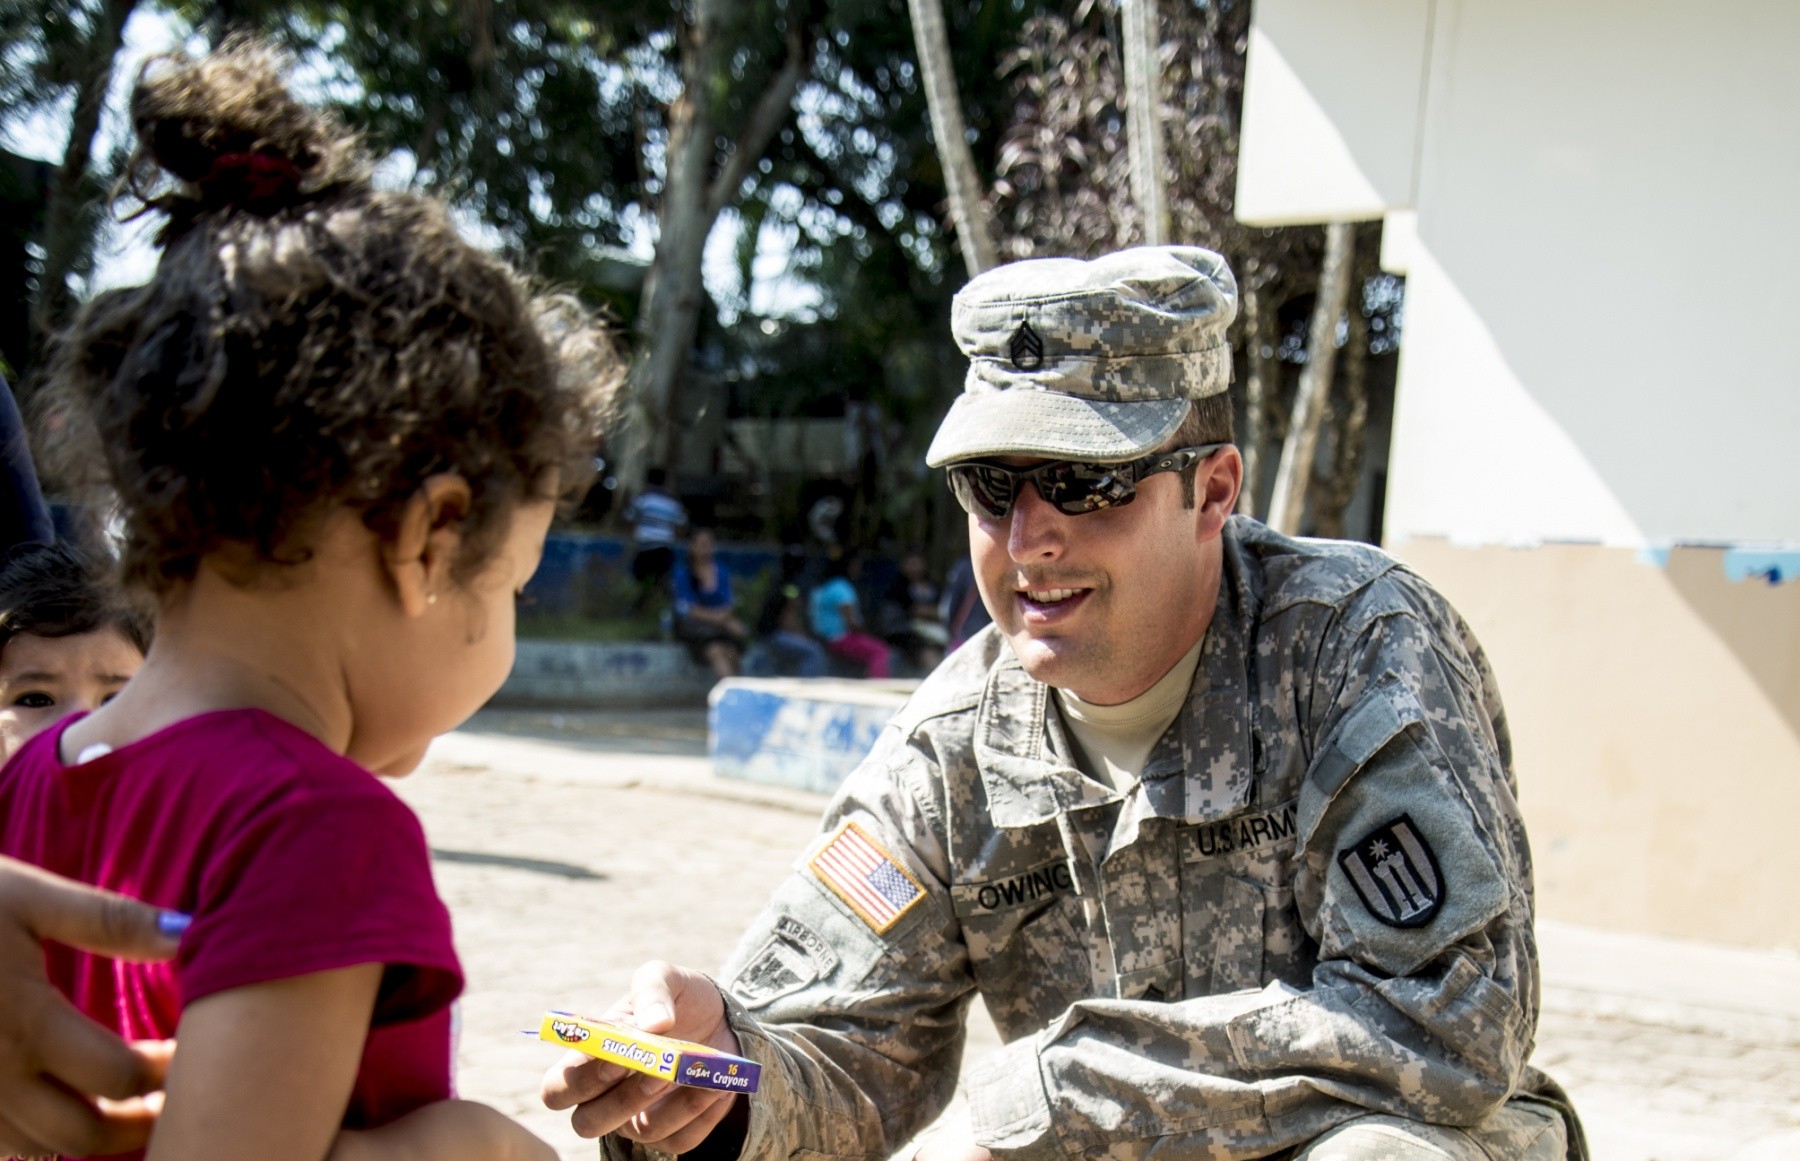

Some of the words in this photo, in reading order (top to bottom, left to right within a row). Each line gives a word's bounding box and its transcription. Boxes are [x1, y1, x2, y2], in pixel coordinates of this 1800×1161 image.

[784, 919, 834, 969] AIRBORNE
[602, 1038, 657, 1068] Crayons
[659, 1052, 675, 1073] 16
[712, 1071, 749, 1088] Crayons
[727, 1063, 738, 1075] 16
